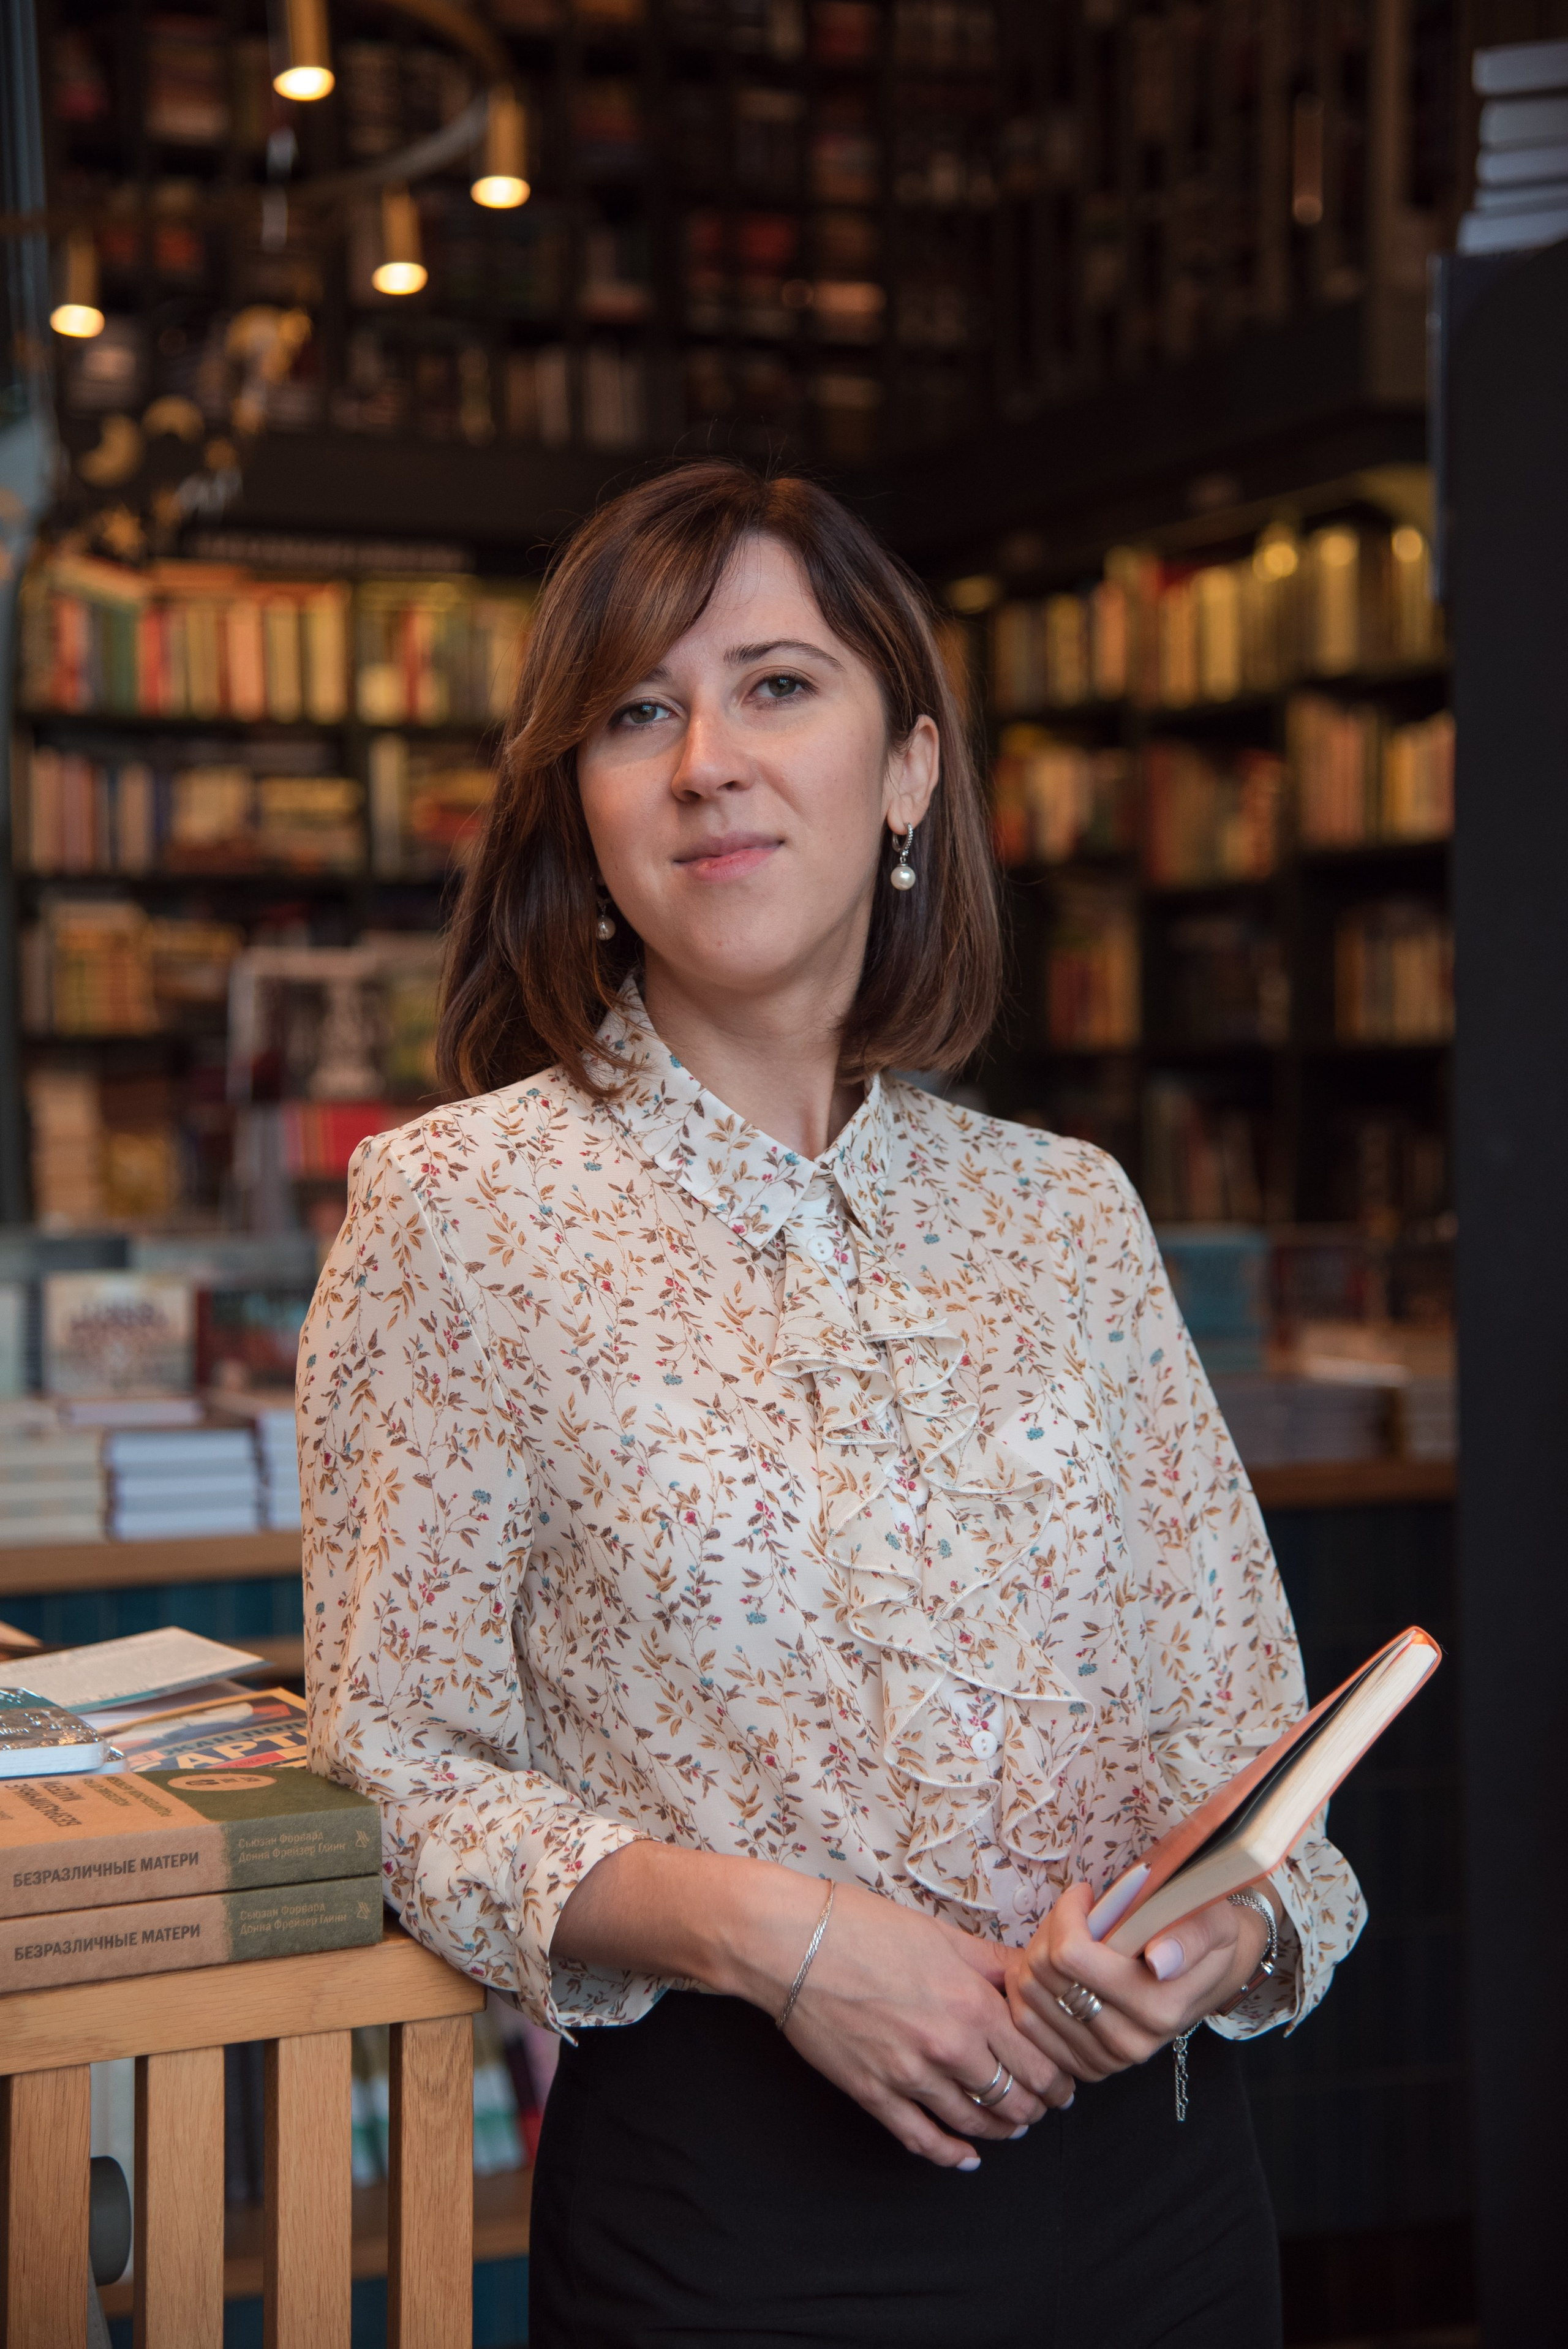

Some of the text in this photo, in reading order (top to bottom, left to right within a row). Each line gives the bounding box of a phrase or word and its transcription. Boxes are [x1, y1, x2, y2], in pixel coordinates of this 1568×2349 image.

[132, 1729, 307, 1772] АРТ
[160, 1720, 307, 1755] ЖАН ПОЛ
[4, 1783, 82, 1827] БЕЗРАЗЛИЧНЫЕ
[37, 1781, 86, 1802] МАТЕРИ
[238, 1831, 324, 1849] Сьюзан Форвард
[238, 1841, 347, 1864] Донна Фрейзер Глинн
[12, 1852, 199, 1888] БЕЗРАЗЛИЧНЫЕ МАТЕРИ
[239, 1902, 326, 1921] Сьюзан Форвард
[239, 1914, 347, 1936] Донна Фрейзер Глинн
[13, 1923, 201, 1961] БЕЗРАЗЛИЧНЫЕ МАТЕРИ
